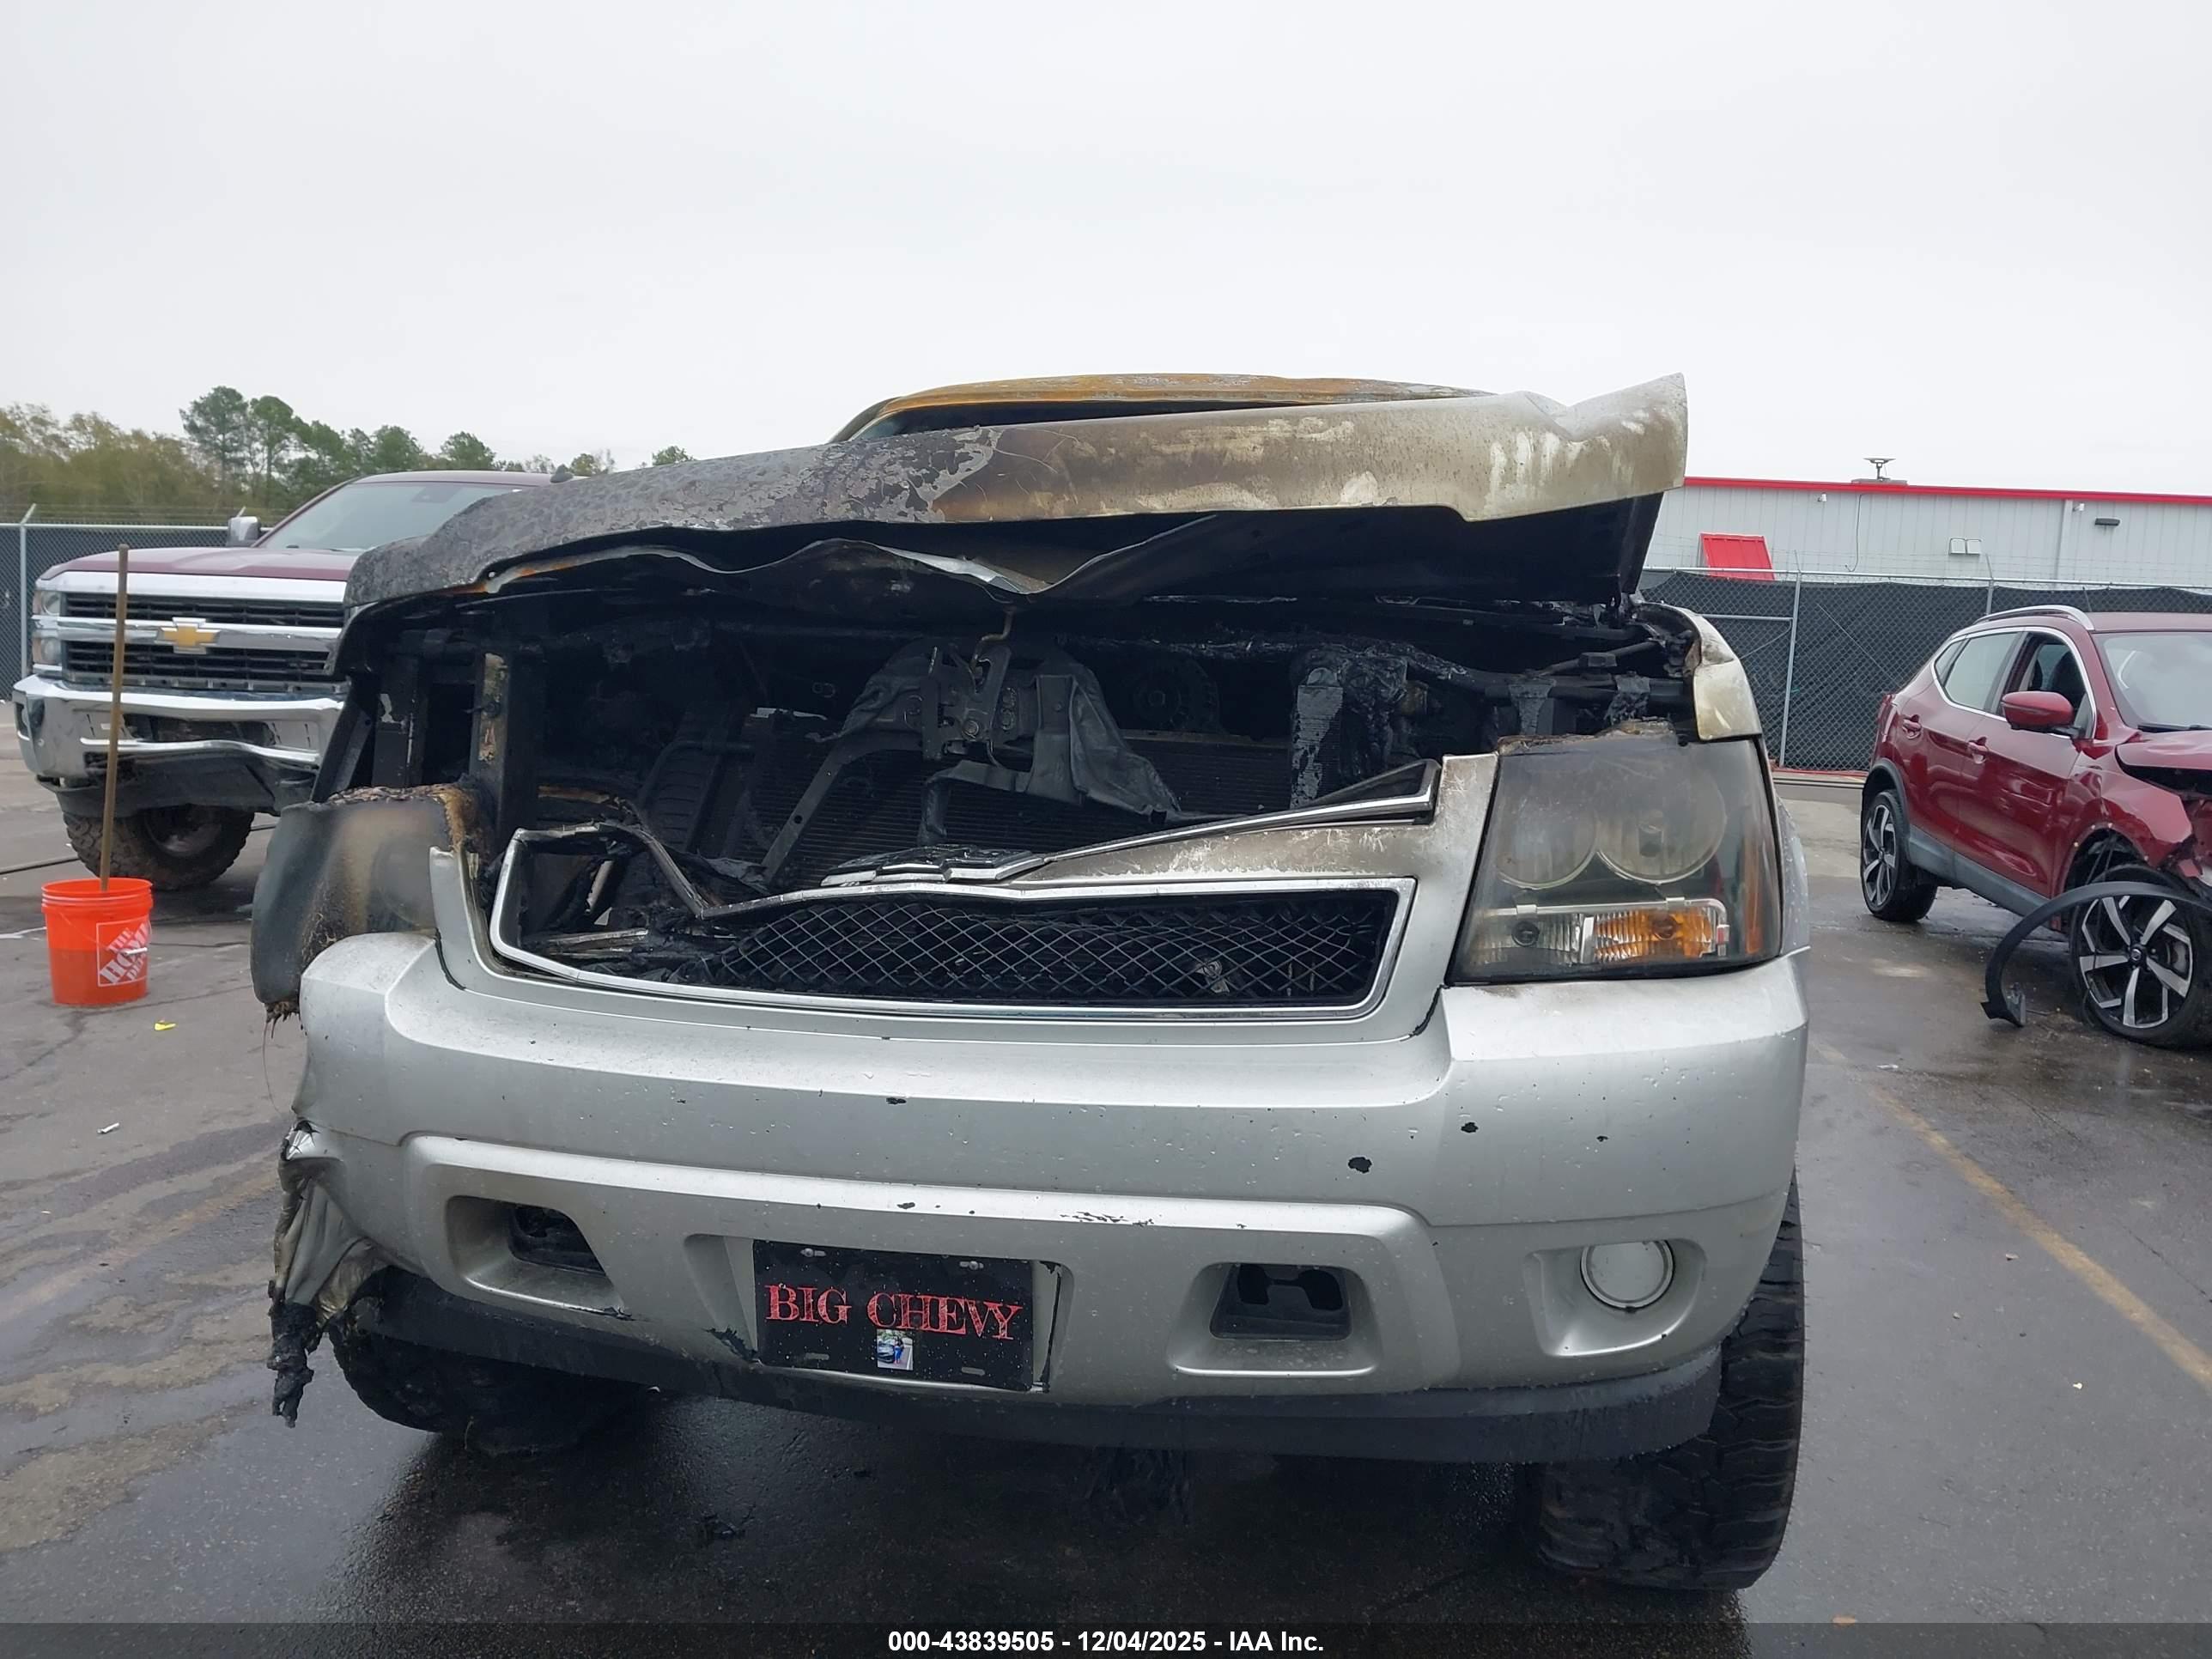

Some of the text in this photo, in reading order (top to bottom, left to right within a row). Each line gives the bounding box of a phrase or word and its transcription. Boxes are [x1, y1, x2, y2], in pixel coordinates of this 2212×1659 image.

[106, 927, 133, 954] THE
[766, 1285, 1023, 1340] BIG CHEVY
